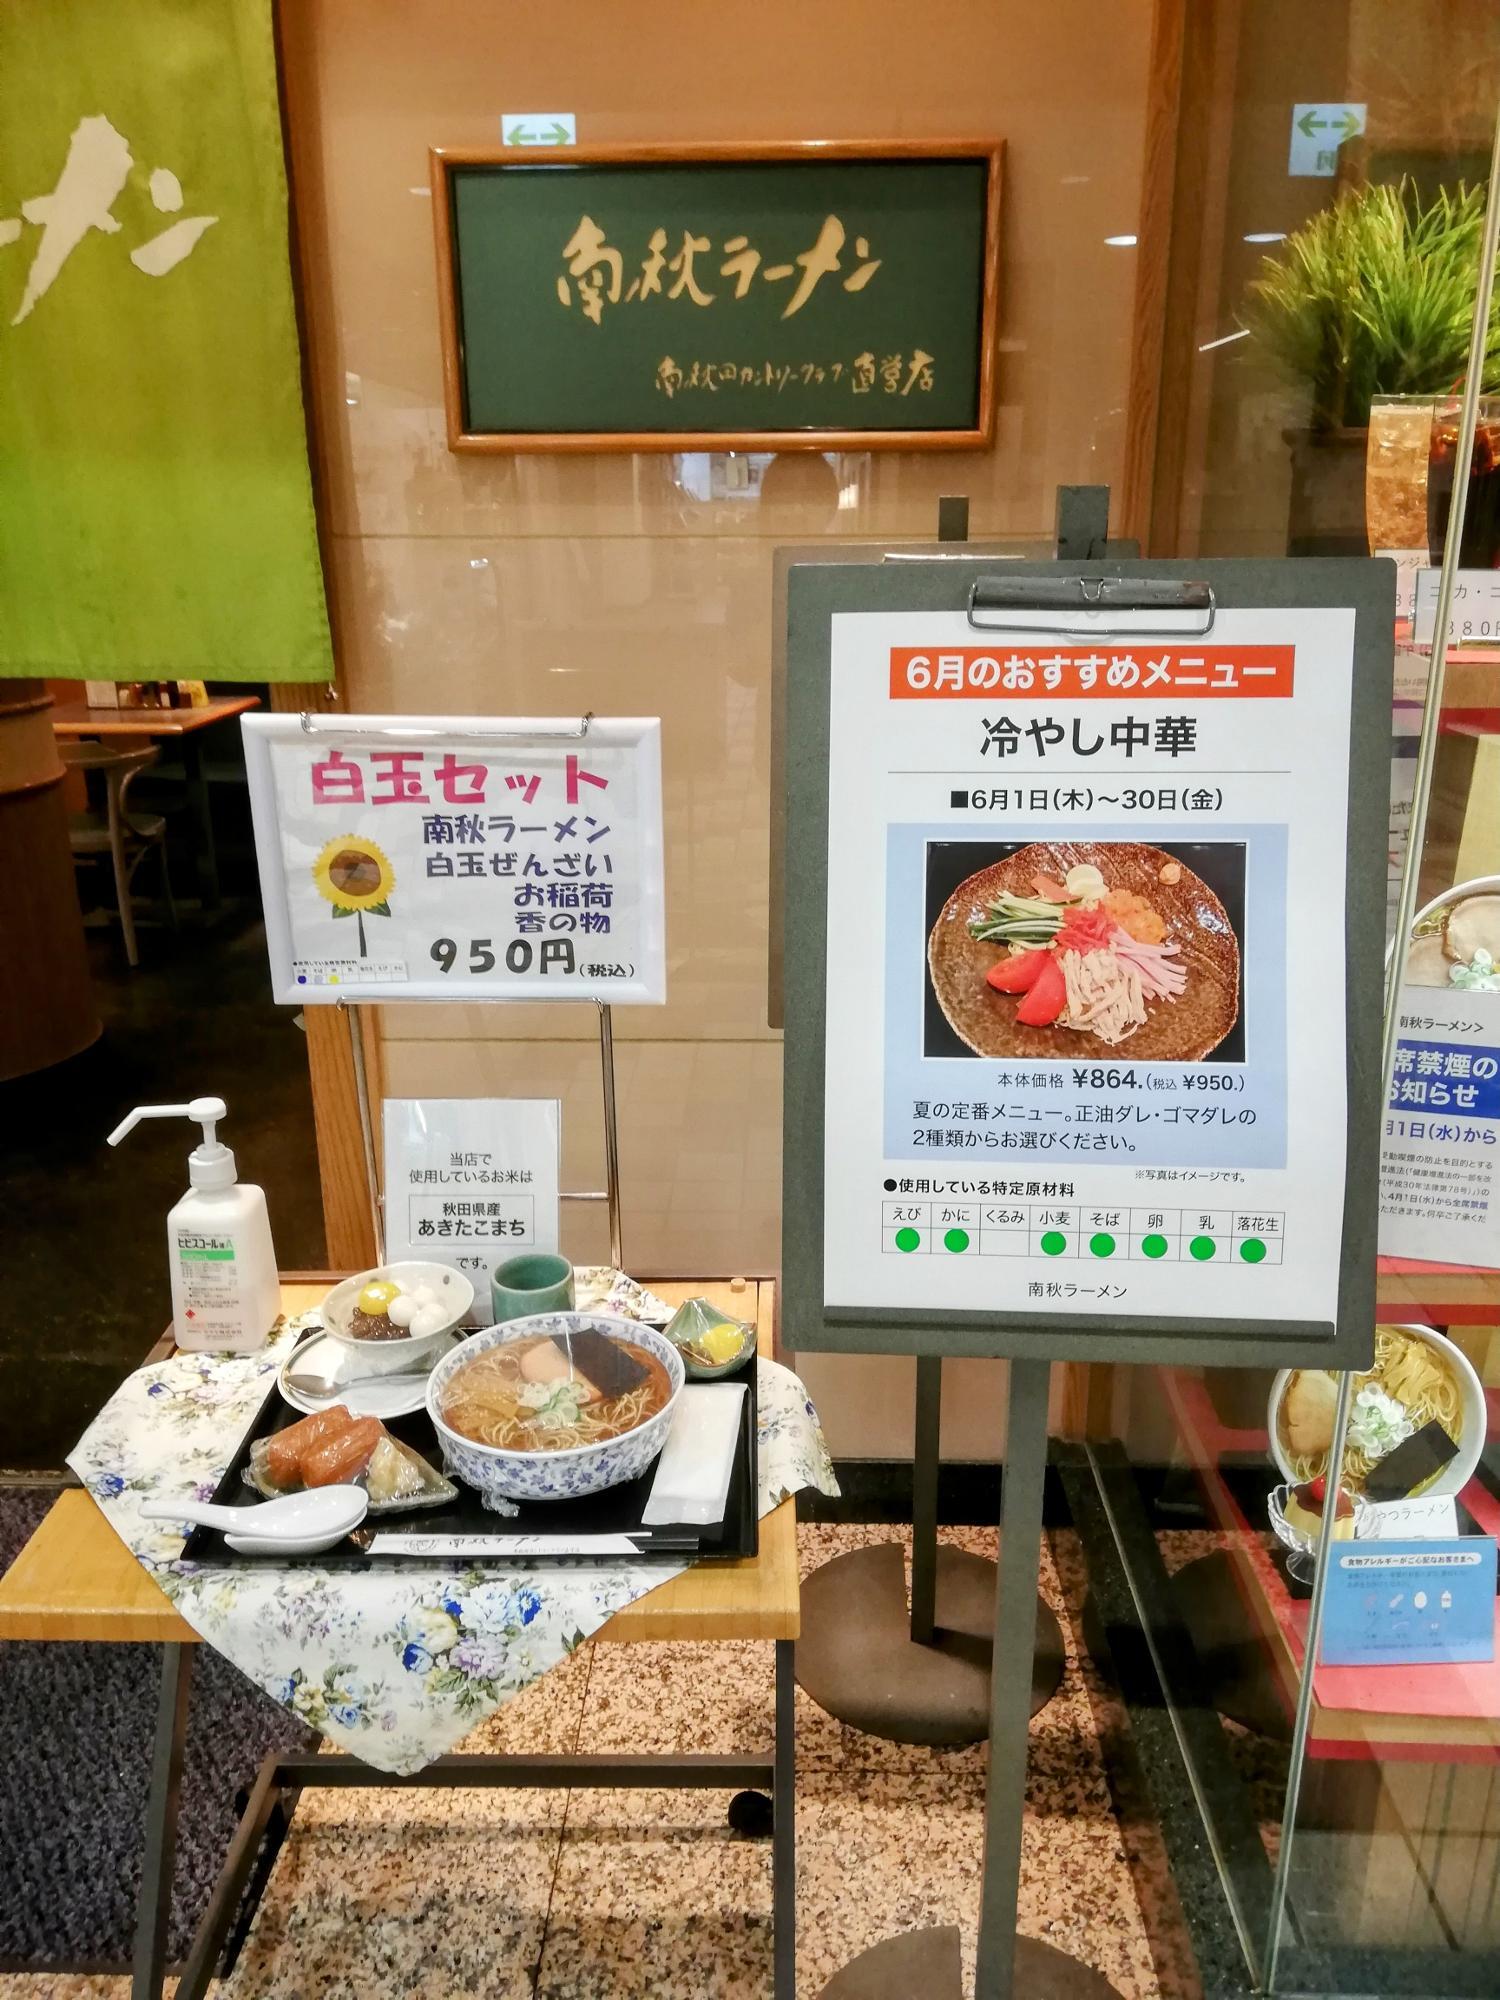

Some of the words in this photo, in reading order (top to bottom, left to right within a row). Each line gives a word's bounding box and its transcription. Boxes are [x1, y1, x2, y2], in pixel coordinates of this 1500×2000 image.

[0, 113, 218, 326] メン
[557, 214, 882, 326] 南秋ラーメン
[906, 654, 1277, 691] 6月のおすすめメニュー
[979, 715, 1198, 758] 冷やし中華
[311, 750, 609, 805] 白玉セット
[421, 814, 612, 845] 南秋ラーメン
[425, 852, 613, 878] 白玉ぜんざい
[513, 882, 613, 908] お稲荷
[514, 911, 612, 934] 香の物
[997, 1072, 1064, 1089] 本体価格
[912, 1128, 1137, 1153] 2種類からお選びください。
[450, 1152, 492, 1167] 当店で
[409, 1169, 533, 1184] 使用しているお米は
[442, 1202, 501, 1217] 秋田県産
[892, 1206, 921, 1222] えび
[941, 1207, 970, 1223] かに
[985, 1209, 1025, 1225] くるみ
[1039, 1210, 1071, 1226] 小麦
[418, 1218, 525, 1237] あきたこまち
[1090, 1211, 1120, 1227] そば
[1147, 1213, 1164, 1229] 卵
[1198, 1214, 1215, 1230] 乳
[1237, 1216, 1279, 1233] 落花生
[456, 1256, 488, 1271] です。
[1028, 1282, 1128, 1299] 南秋ラーメン
